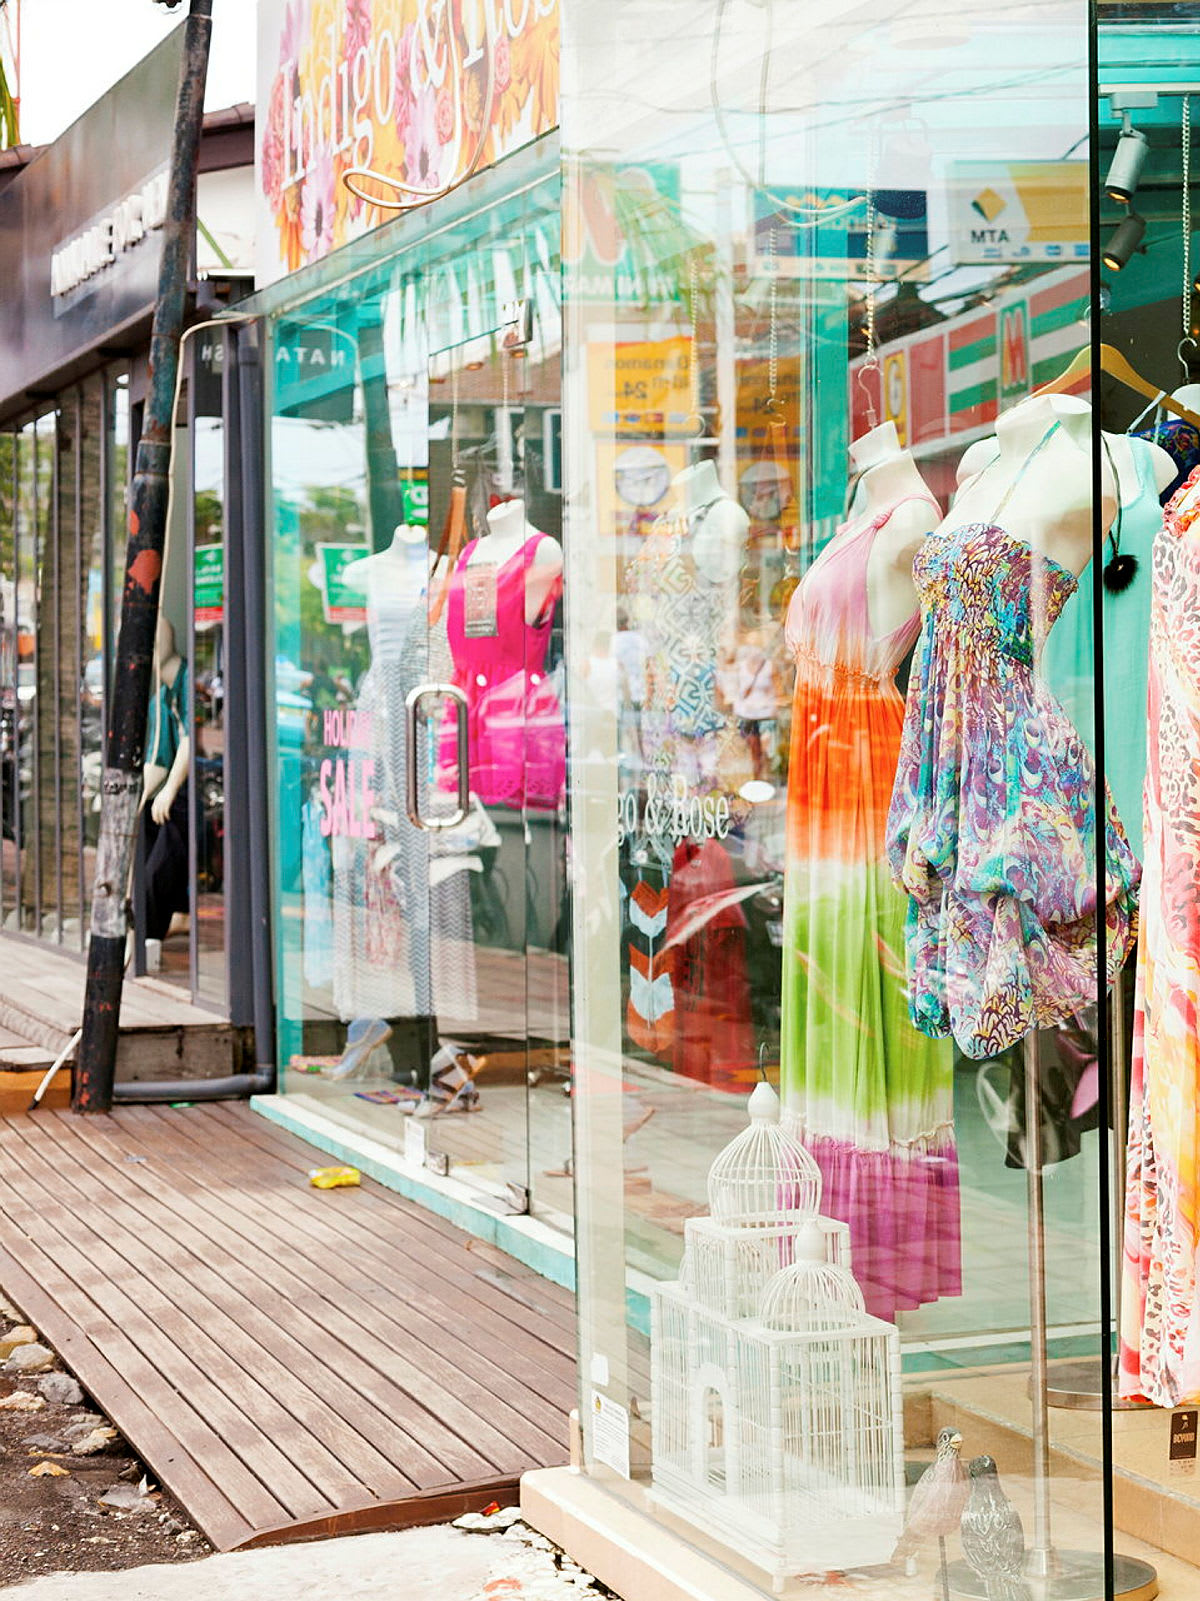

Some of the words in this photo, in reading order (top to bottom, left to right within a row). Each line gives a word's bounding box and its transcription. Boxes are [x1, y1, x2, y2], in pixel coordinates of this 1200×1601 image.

[279, 22, 398, 191] Indigo
[323, 709, 374, 748] HOLID
[320, 758, 376, 838] SALE
[644, 772, 672, 836] &
[669, 772, 730, 847] Rose
